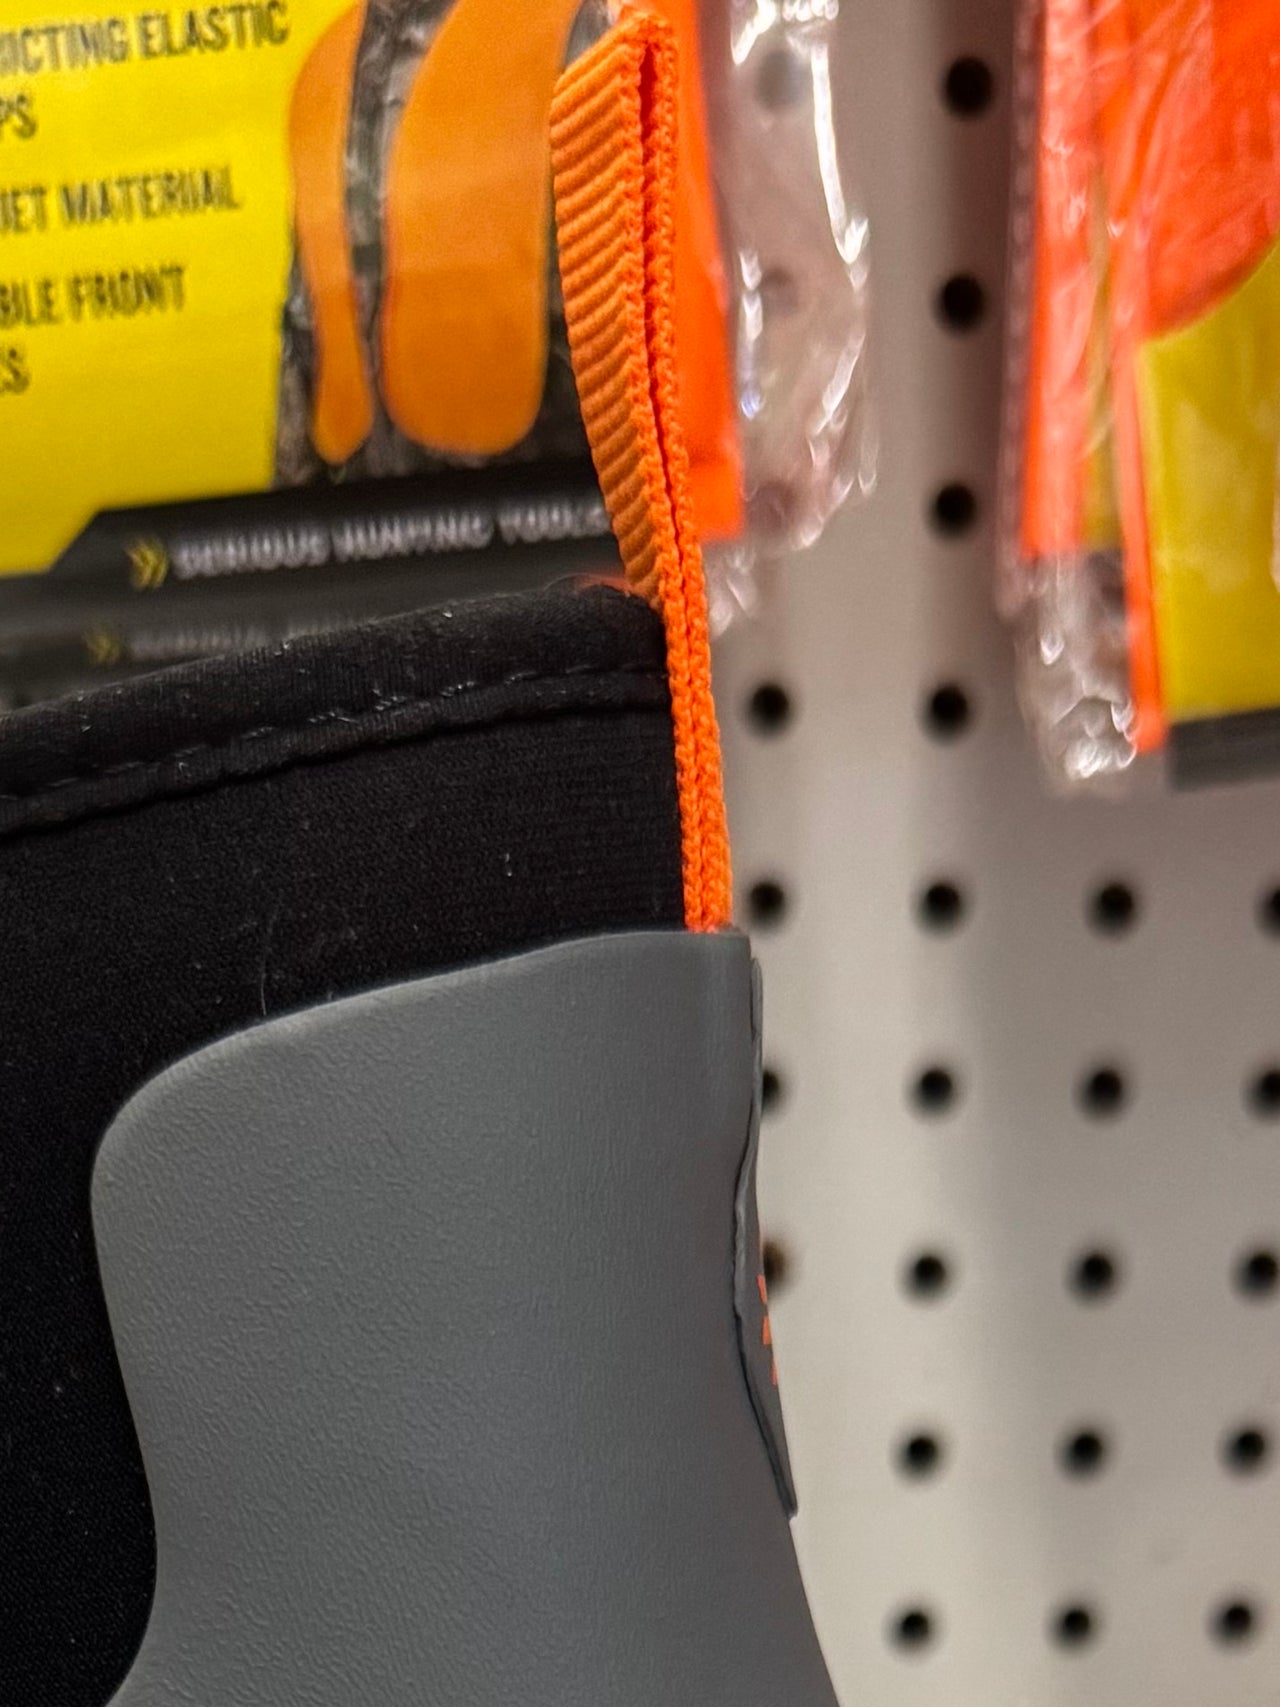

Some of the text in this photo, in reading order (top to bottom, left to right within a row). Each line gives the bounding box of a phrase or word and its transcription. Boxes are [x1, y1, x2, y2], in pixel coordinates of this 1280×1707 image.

[136, 0, 290, 59] ELASTIC
[59, 164, 241, 223] MATERIAL
[67, 264, 186, 319] FRONT
